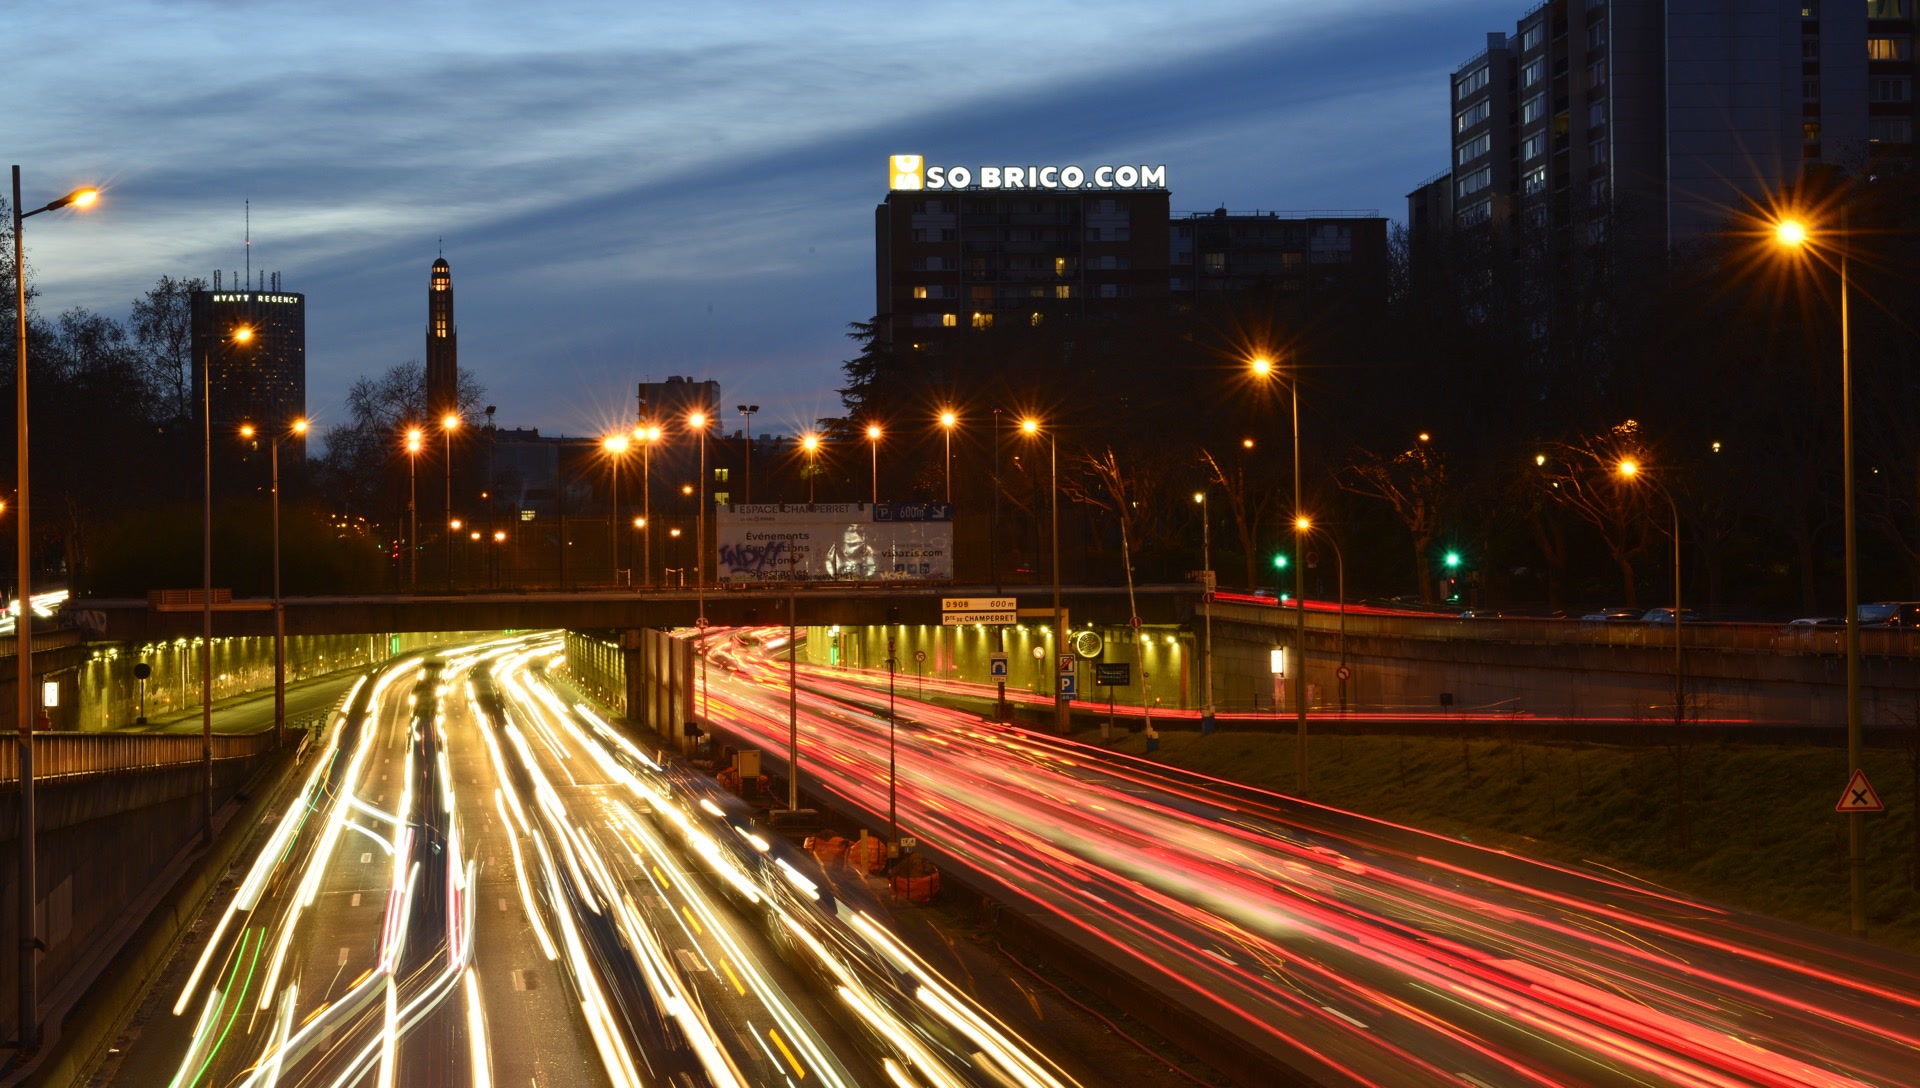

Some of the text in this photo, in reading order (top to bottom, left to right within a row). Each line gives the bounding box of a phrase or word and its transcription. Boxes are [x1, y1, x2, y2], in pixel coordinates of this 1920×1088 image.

[926, 164, 1166, 189] SO BRICO.COM
[258, 295, 298, 303] REGENCY
[740, 505, 778, 514] ESPACE
[746, 530, 810, 541] Événements
[990, 600, 1007, 608] 600
[964, 615, 1015, 623] CHAMPERRET
[1061, 677, 1071, 691] P
